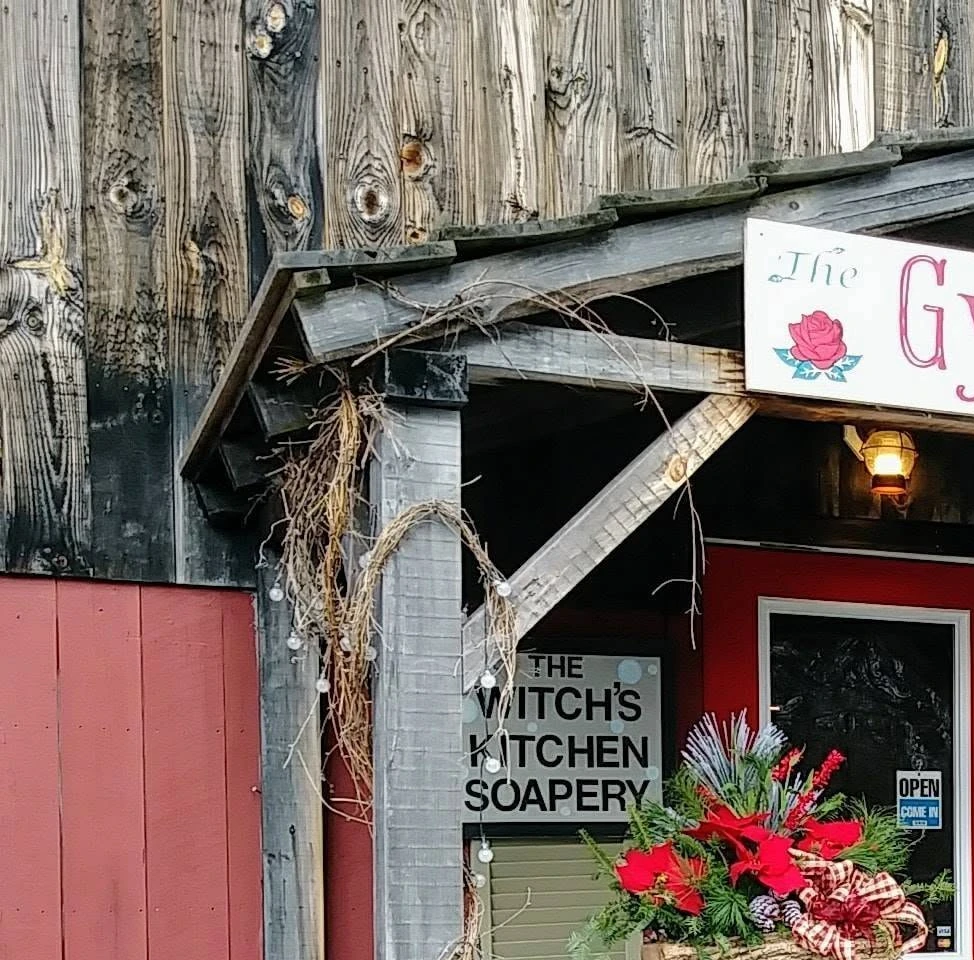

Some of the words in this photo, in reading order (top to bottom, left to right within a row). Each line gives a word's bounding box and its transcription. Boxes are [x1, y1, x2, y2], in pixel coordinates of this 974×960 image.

[767, 246, 858, 288] The
[527, 654, 584, 679] THE
[475, 681, 642, 722] WITCH'S
[469, 734, 649, 769] KITCHEN
[463, 778, 651, 813] SOAPERY
[899, 777, 940, 798] OPEN
[900, 805, 927, 818] COME
[928, 806, 939, 818] IN
